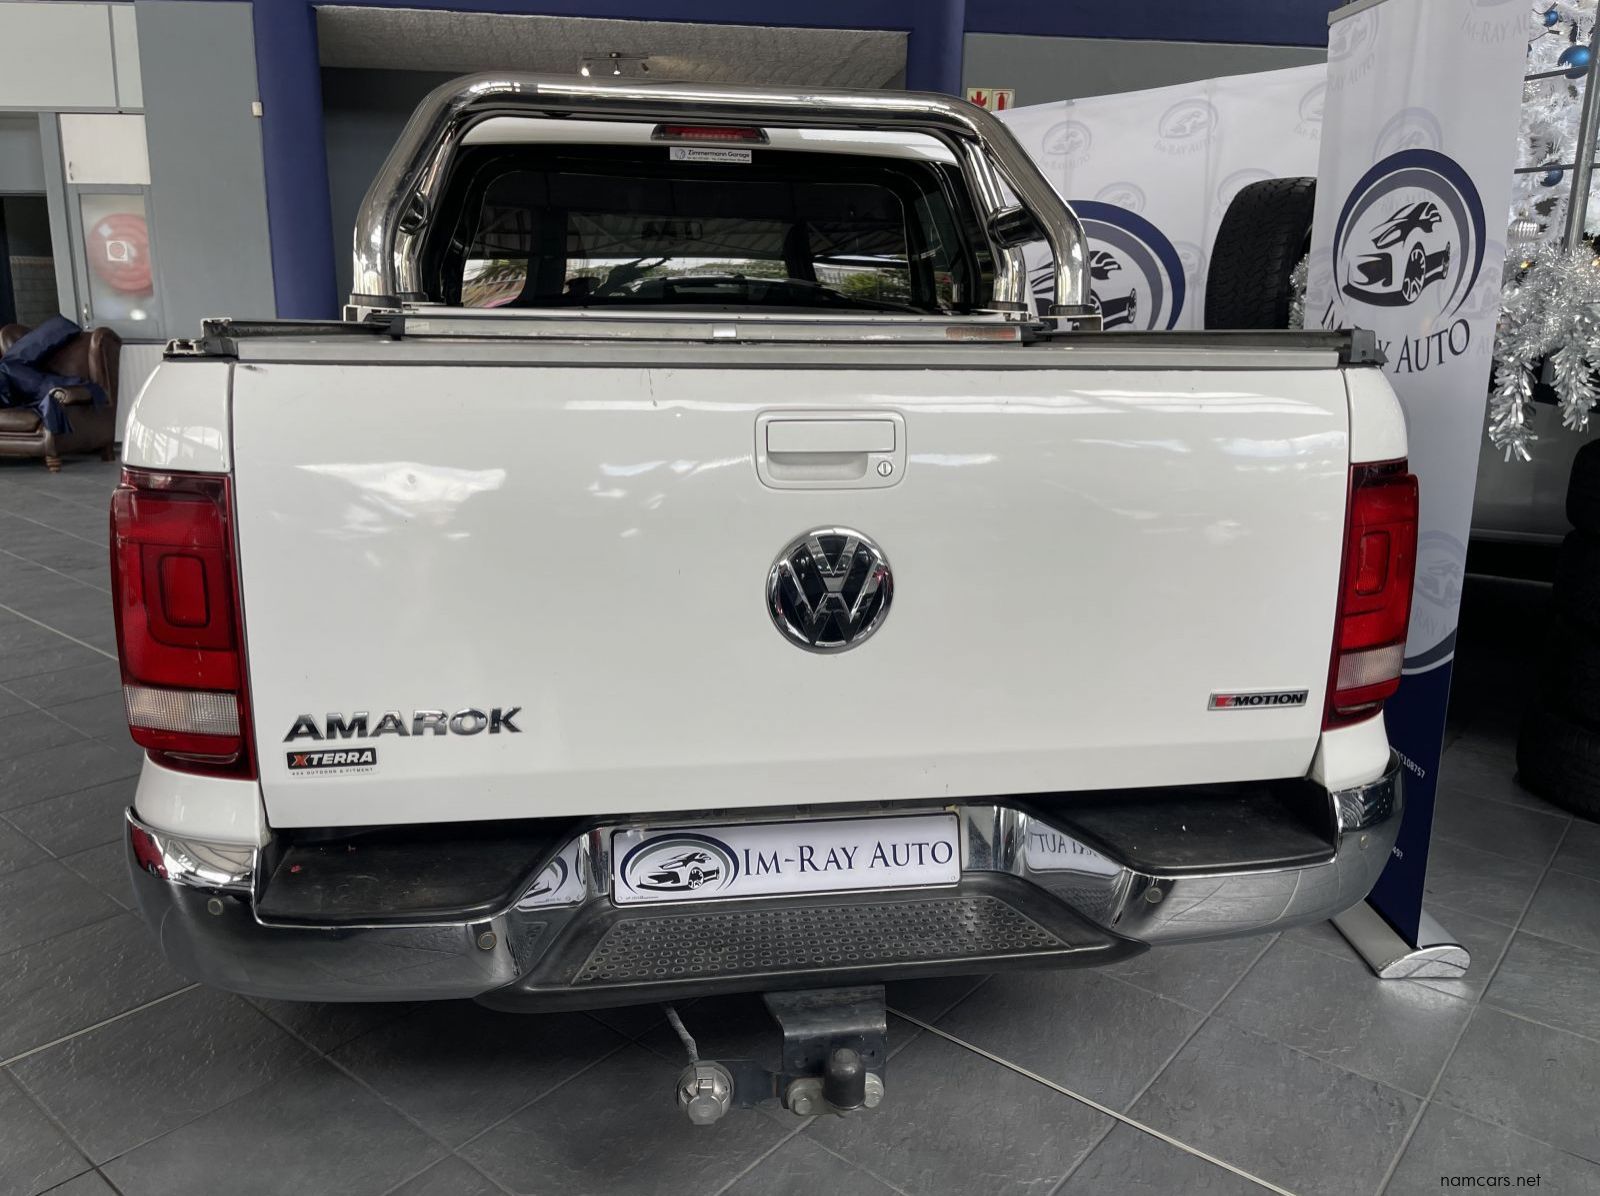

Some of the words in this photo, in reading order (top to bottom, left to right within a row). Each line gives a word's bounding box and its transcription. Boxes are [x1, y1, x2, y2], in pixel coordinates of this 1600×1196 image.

[687, 149, 728, 157] Zimmermann
[1393, 318, 1471, 374] AUTO
[282, 706, 522, 743] AMAROK
[291, 750, 373, 767] XTERRA
[742, 845, 859, 877] IM-RAY
[869, 840, 954, 868] AUTO
